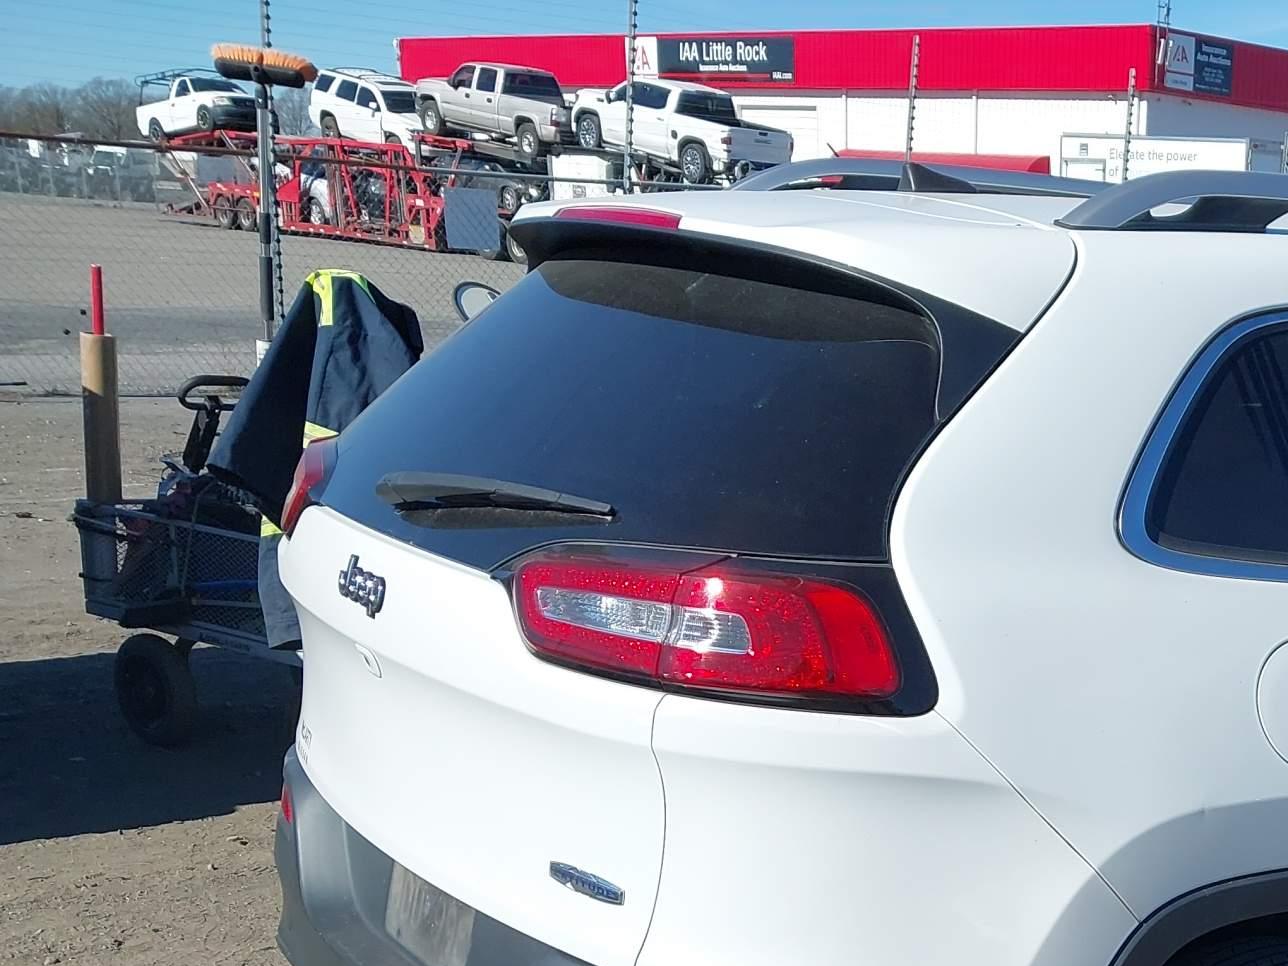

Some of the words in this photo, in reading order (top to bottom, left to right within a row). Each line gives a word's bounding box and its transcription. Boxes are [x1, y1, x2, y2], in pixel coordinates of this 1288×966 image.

[679, 41, 699, 61] IAA
[702, 41, 733, 61] Little
[736, 41, 768, 61] Rock
[1109, 147, 1145, 161] Eleate
[1148, 148, 1164, 161] the
[1166, 151, 1198, 164] power
[1108, 165, 1120, 177] of
[338, 554, 386, 619] Jeep
